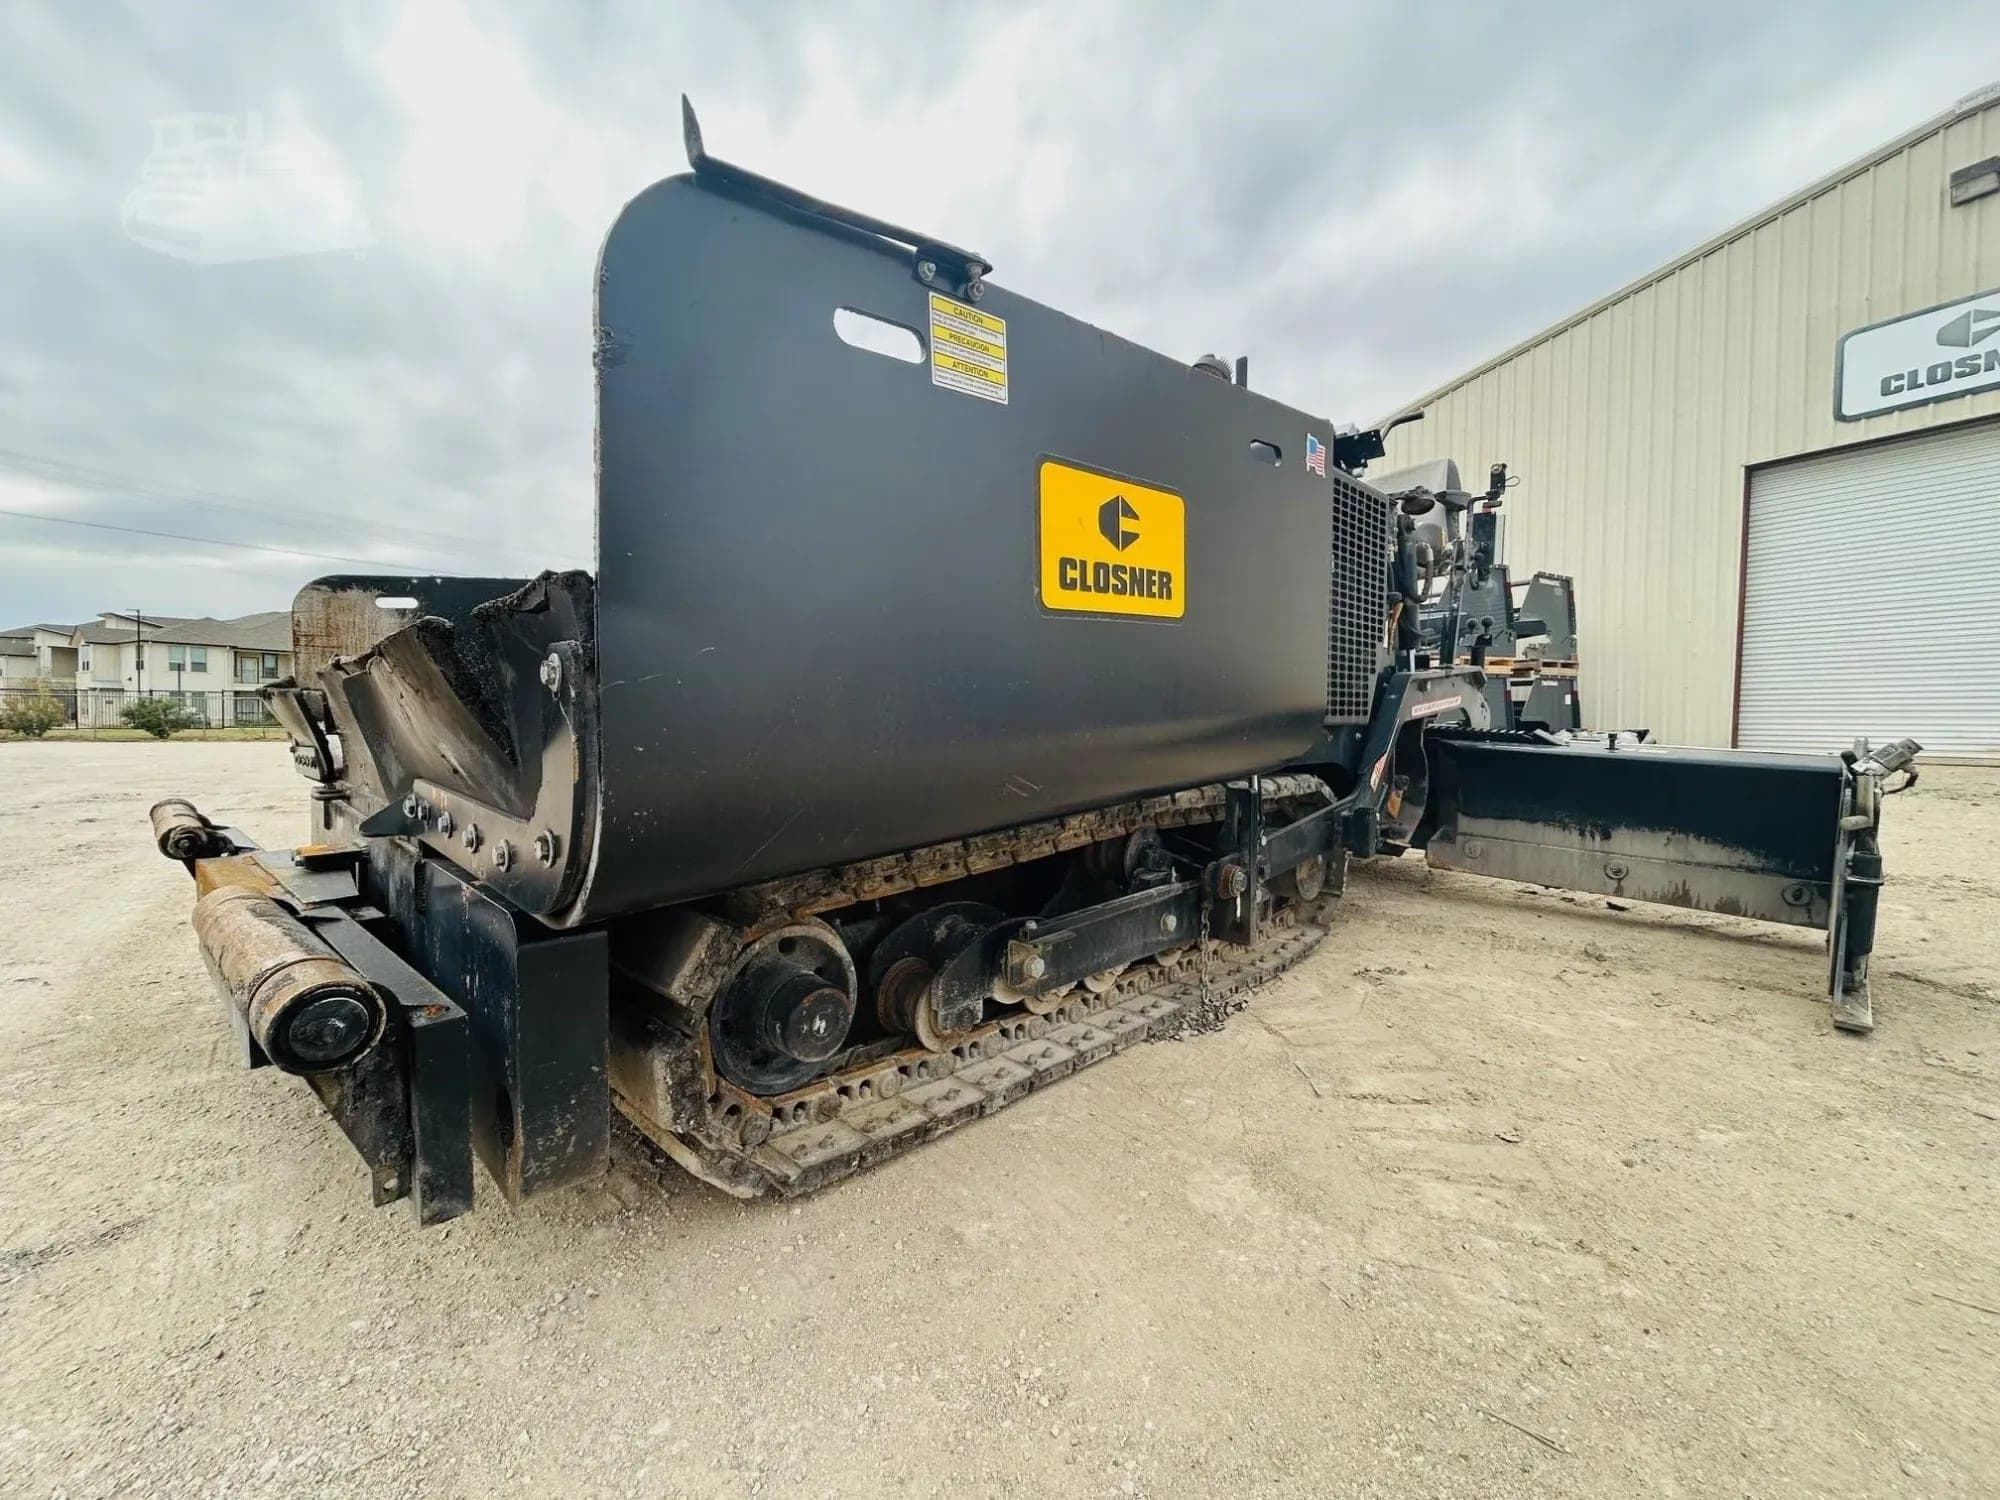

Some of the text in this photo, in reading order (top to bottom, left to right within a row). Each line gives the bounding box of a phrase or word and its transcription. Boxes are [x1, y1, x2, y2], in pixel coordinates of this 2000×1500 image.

[953, 307, 983, 324] CAUTION
[952, 361, 989, 379] ATTENTION
[1059, 557, 1172, 600] CLOSNER
